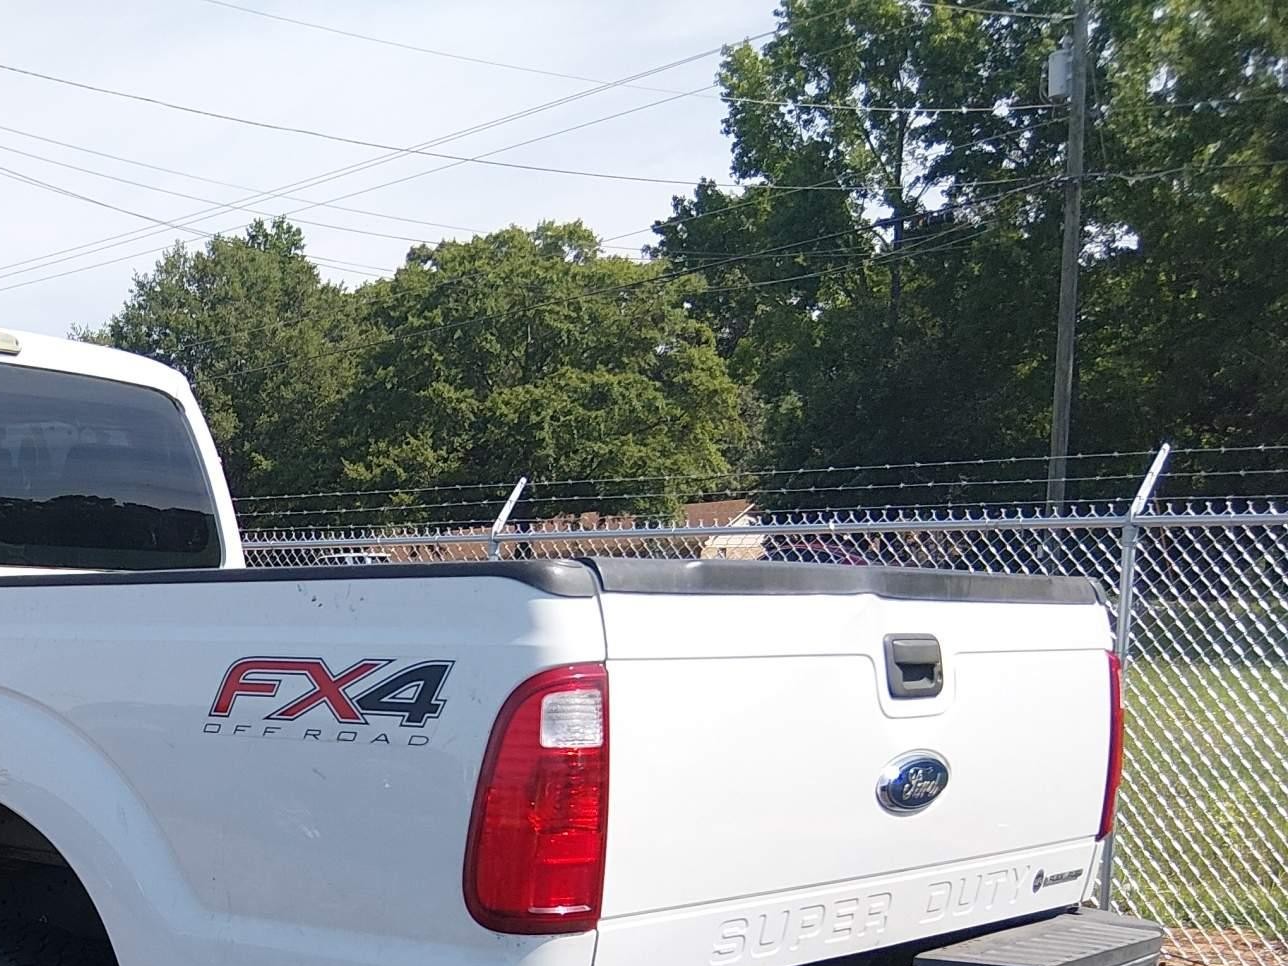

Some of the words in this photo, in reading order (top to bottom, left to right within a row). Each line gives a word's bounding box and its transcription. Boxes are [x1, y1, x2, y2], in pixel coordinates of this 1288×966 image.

[208, 656, 456, 728] FX4
[203, 723, 282, 738] OFF
[303, 729, 430, 746] ROAD
[710, 892, 892, 966] SUPER
[919, 865, 1030, 923] DUTY
